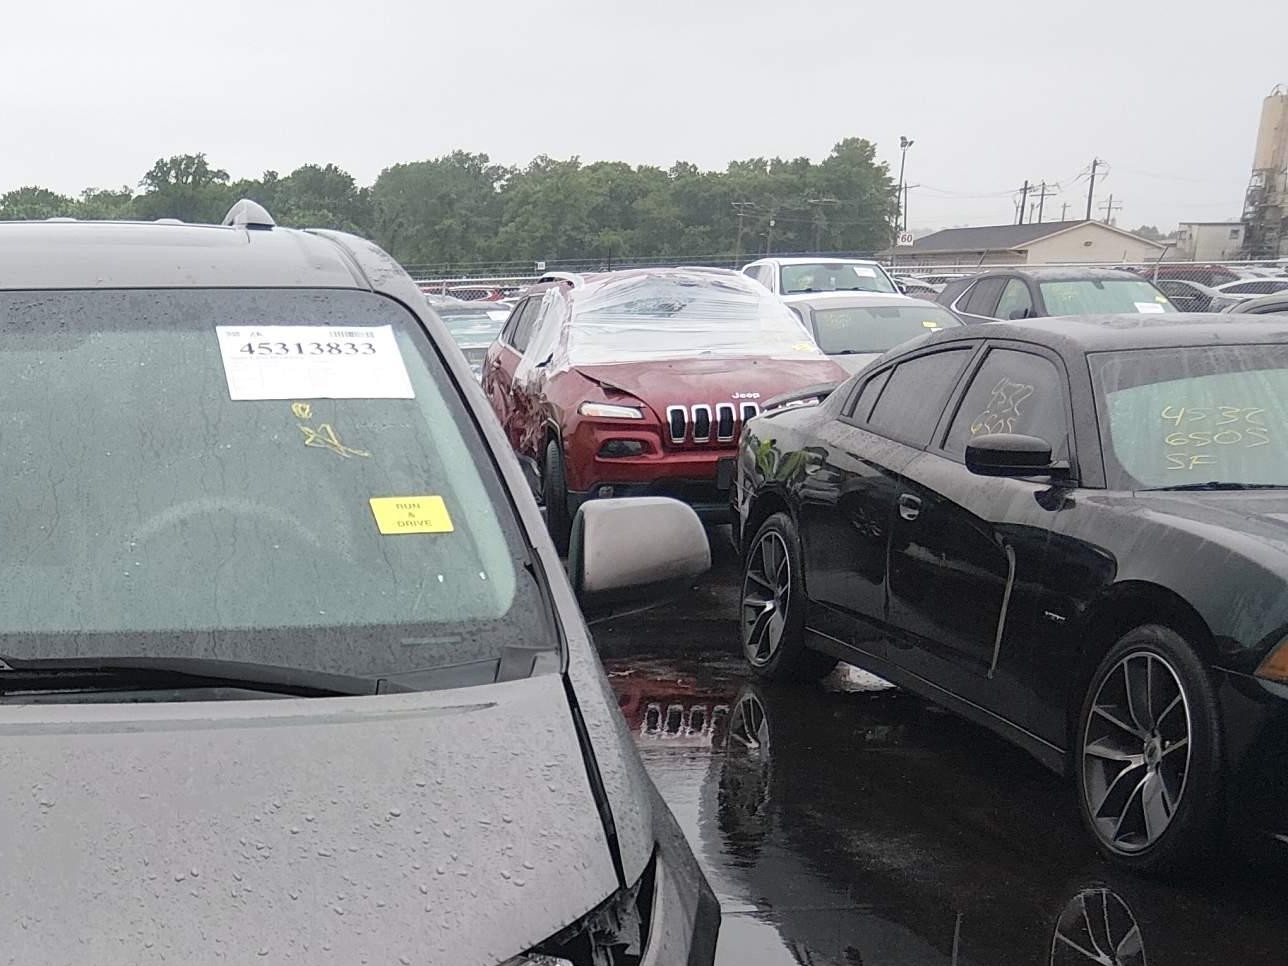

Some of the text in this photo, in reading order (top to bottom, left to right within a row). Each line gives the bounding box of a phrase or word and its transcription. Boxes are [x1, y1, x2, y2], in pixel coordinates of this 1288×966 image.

[239, 342, 377, 356] 45313833
[1165, 427, 1270, 448] 6505
[397, 519, 433, 528] DRIVE
